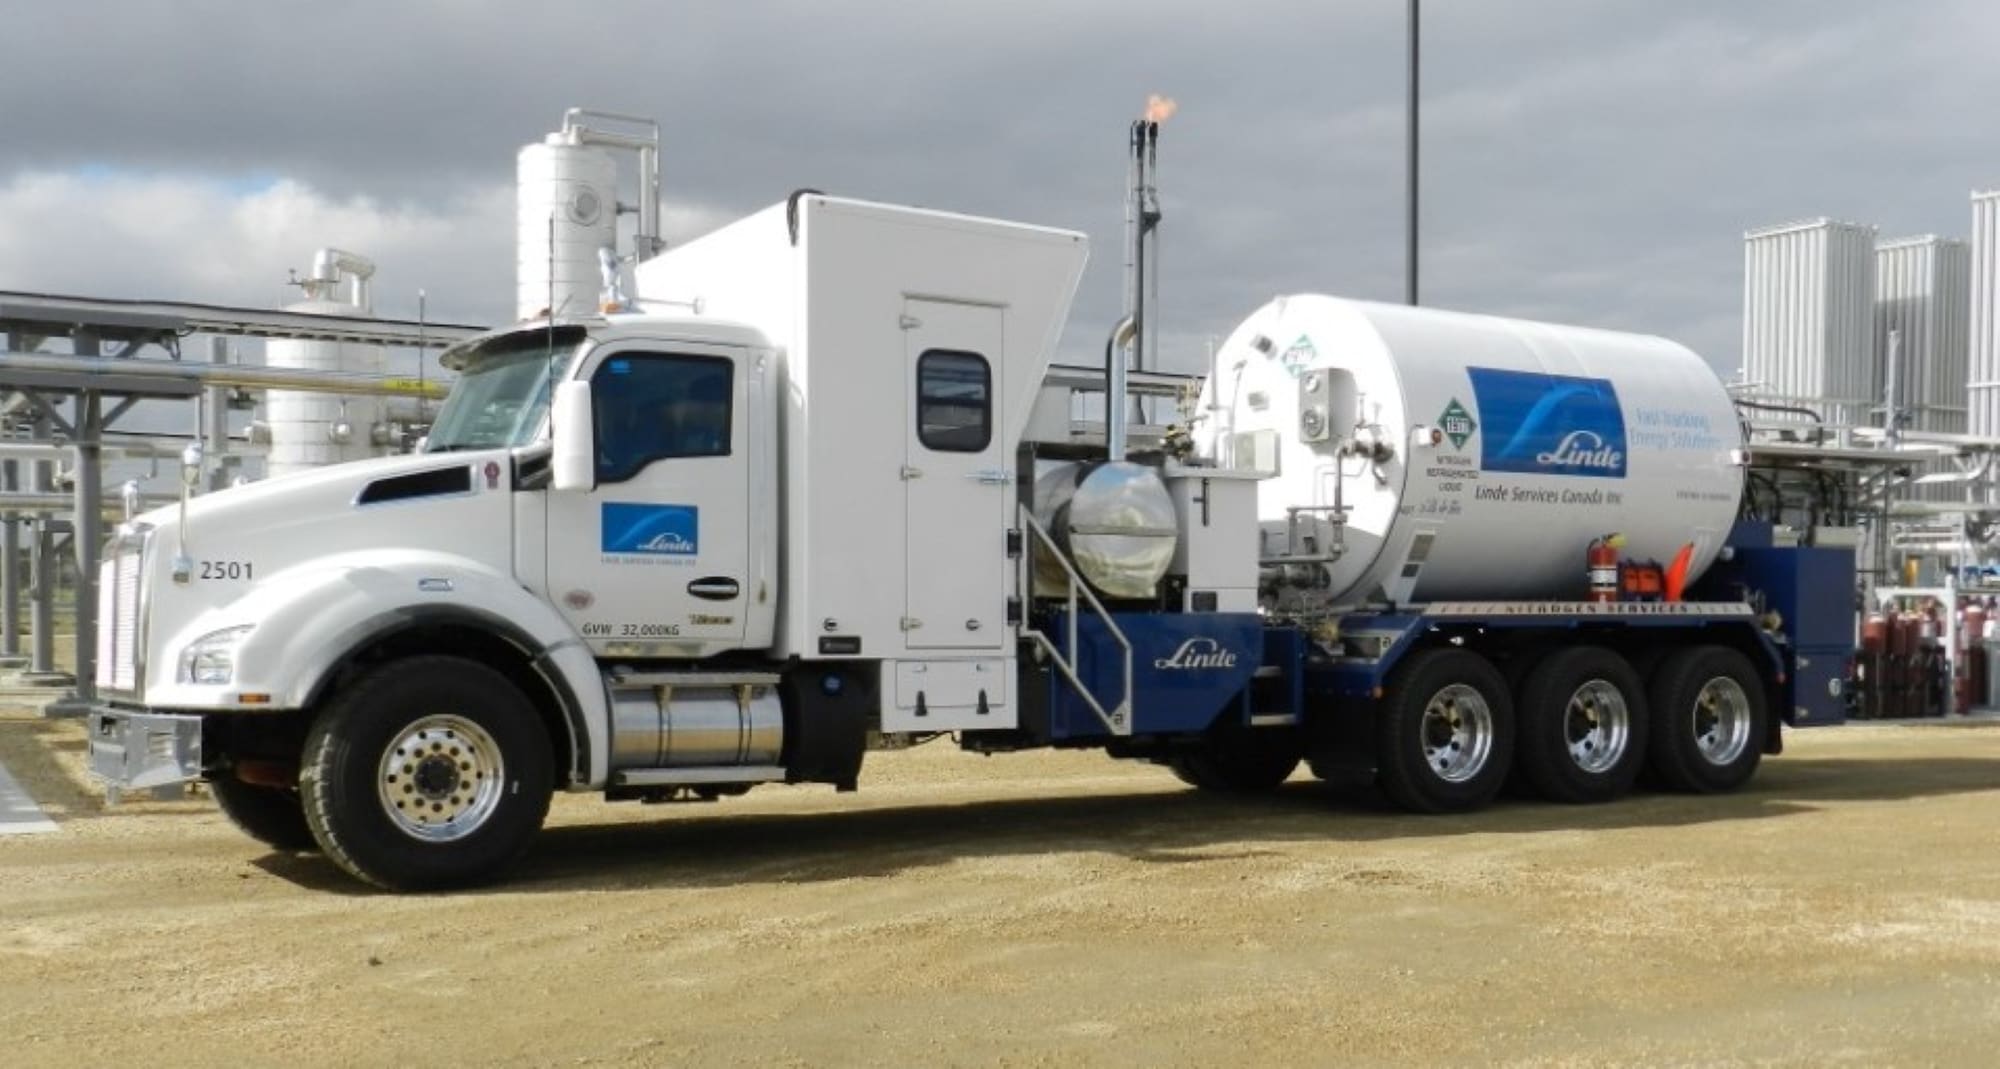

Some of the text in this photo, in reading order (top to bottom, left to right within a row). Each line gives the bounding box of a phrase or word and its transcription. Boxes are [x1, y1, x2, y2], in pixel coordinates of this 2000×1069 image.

[1536, 430, 1622, 468] Linde
[1474, 484, 1508, 501] Linde
[1511, 486, 1559, 504] Services
[1561, 488, 1603, 505] Canada
[636, 532, 694, 552] Linde
[200, 561, 252, 579] 2501
[1505, 603, 1688, 613] NITROGEN SERVICES
[582, 623, 680, 638] GVW 32,000KG
[1155, 638, 1237, 669] Linde
